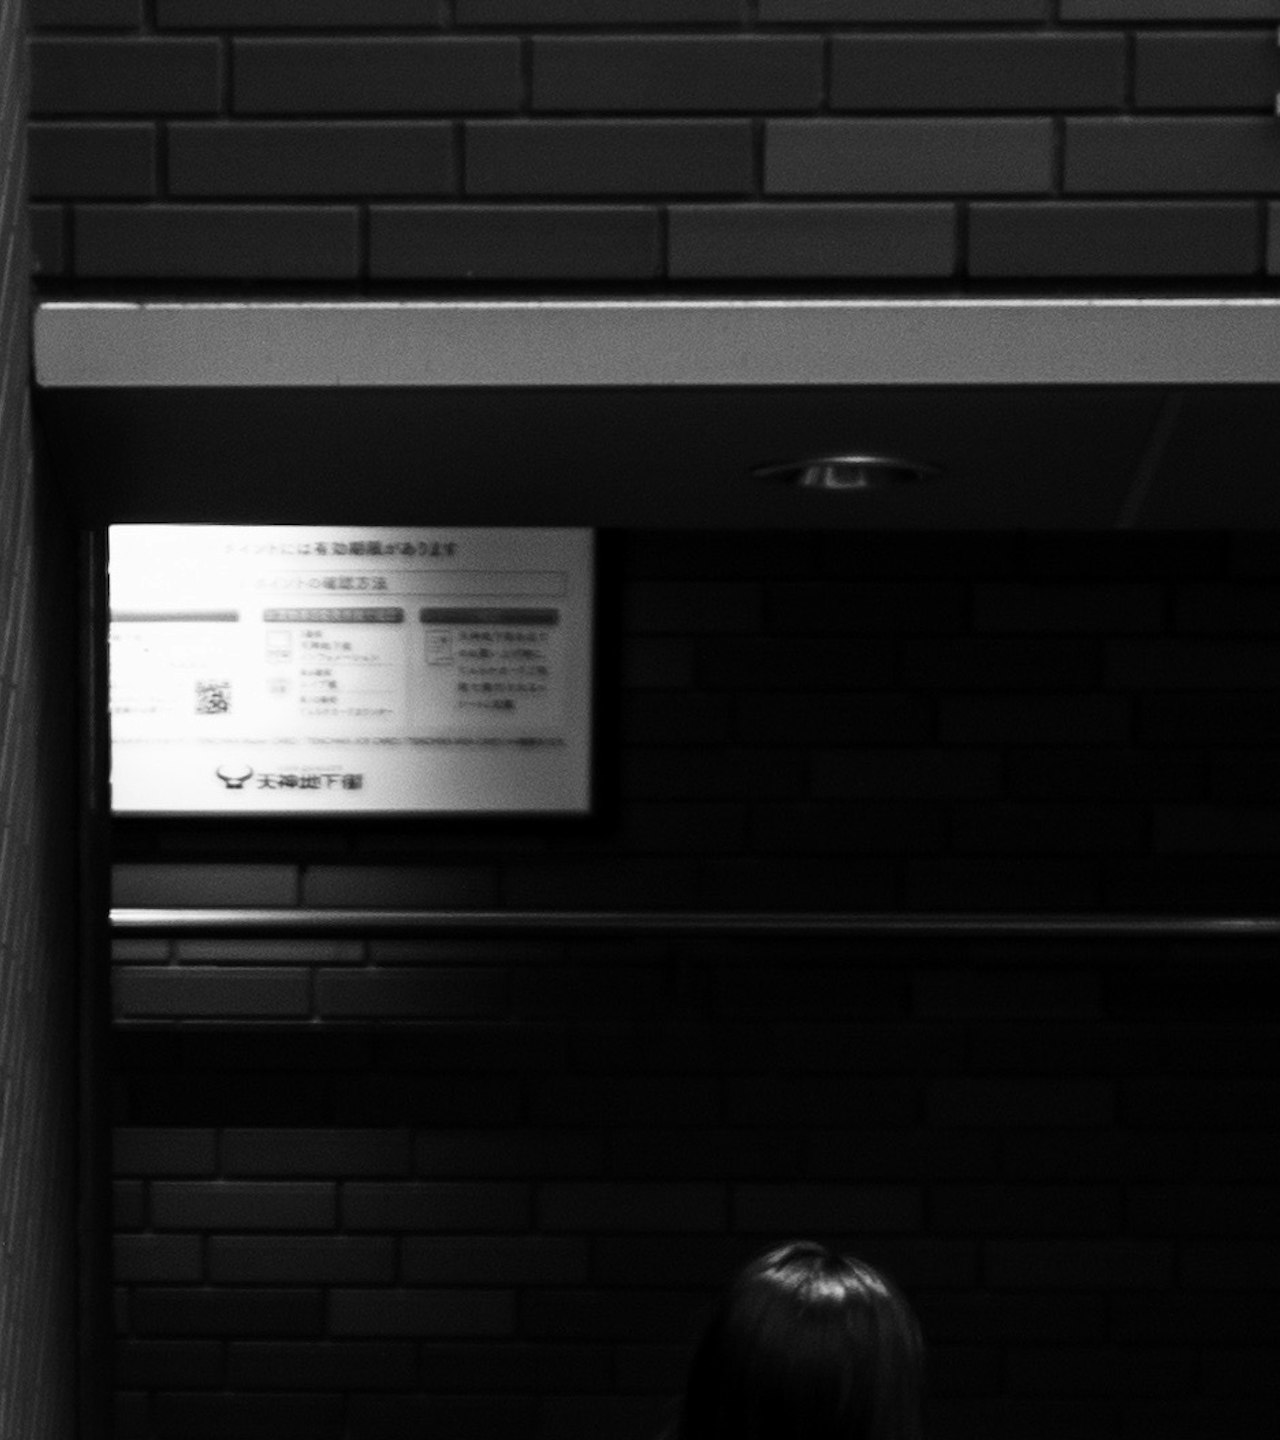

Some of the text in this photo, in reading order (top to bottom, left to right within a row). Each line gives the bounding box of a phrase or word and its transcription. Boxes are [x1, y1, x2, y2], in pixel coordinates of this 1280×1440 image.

[257, 773, 364, 790] 天神地下街
